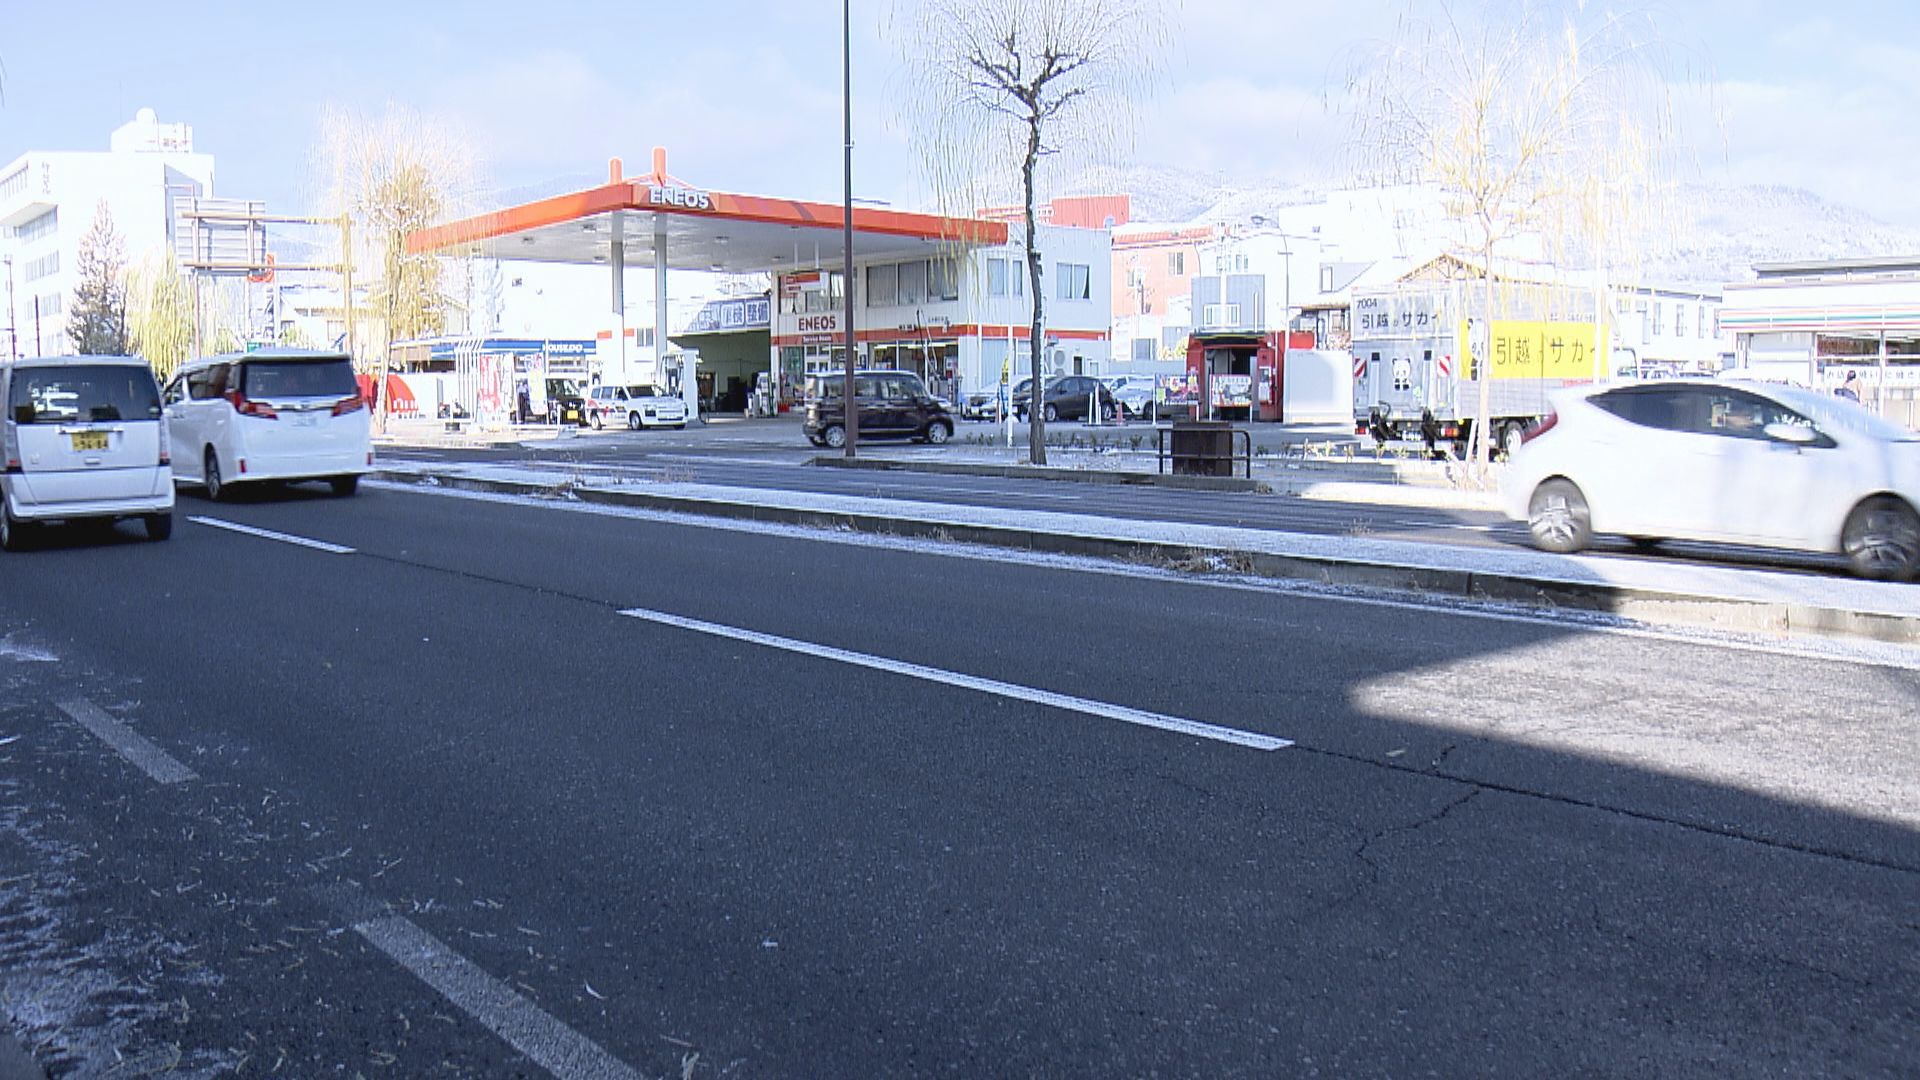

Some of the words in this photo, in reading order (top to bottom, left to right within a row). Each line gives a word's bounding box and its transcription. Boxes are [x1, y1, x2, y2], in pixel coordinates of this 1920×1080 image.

[648, 186, 710, 209] ENEOS
[1356, 298, 1378, 309] 7004
[798, 315, 836, 331] ENEOS
[1496, 336, 1596, 366] 引越サカ
